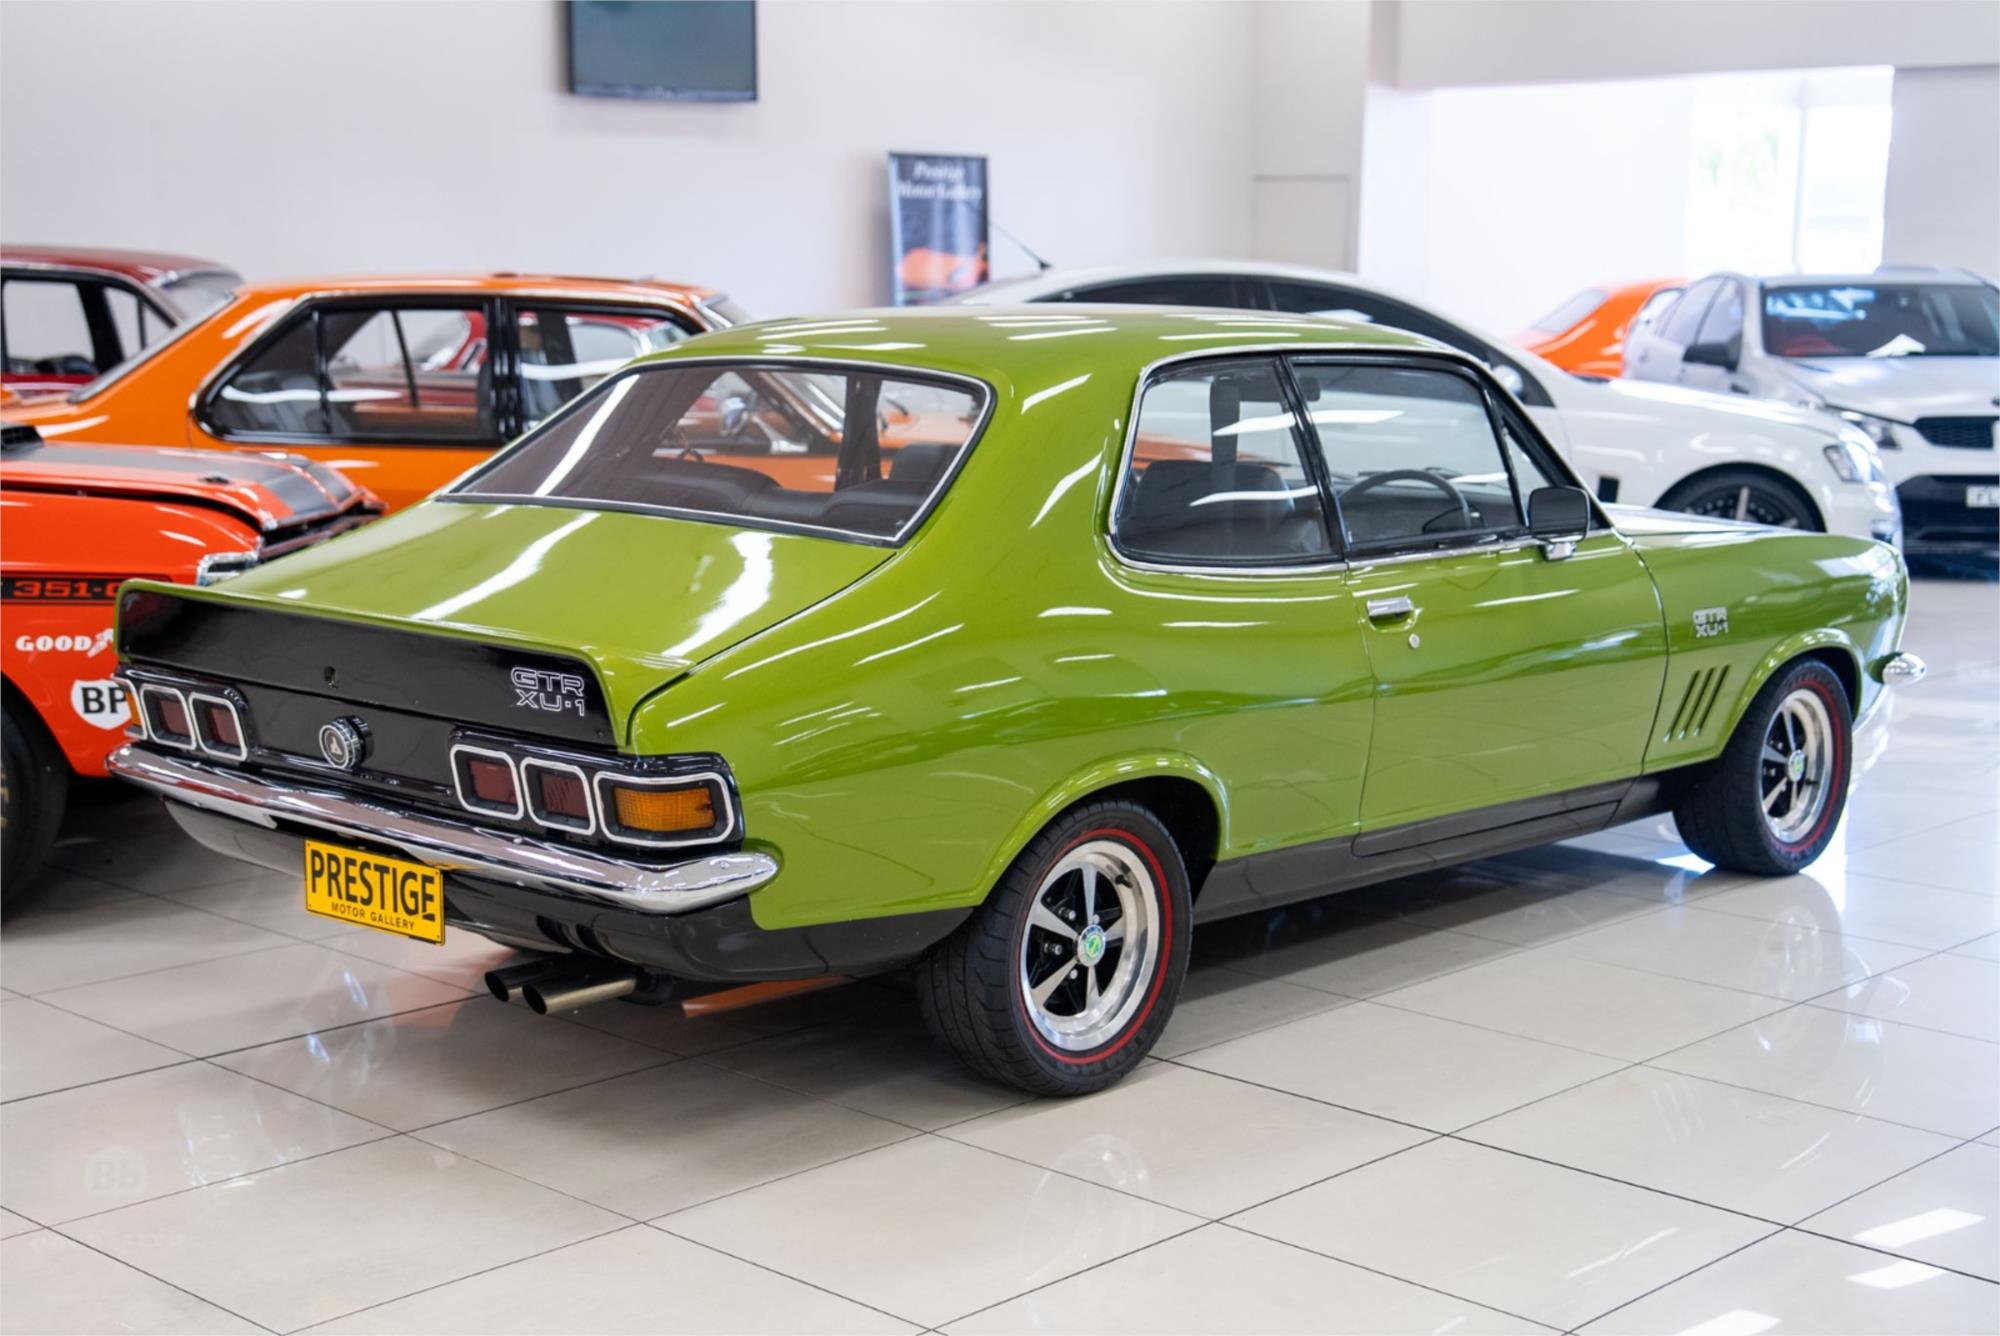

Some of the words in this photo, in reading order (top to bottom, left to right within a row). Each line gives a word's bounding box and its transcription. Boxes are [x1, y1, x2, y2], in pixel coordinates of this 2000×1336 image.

[510, 666, 585, 697] GTR
[81, 686, 126, 714] BP
[310, 849, 436, 922] PRESTIGE
[331, 902, 366, 919] MOTOR
[370, 911, 415, 930] GALLERY
